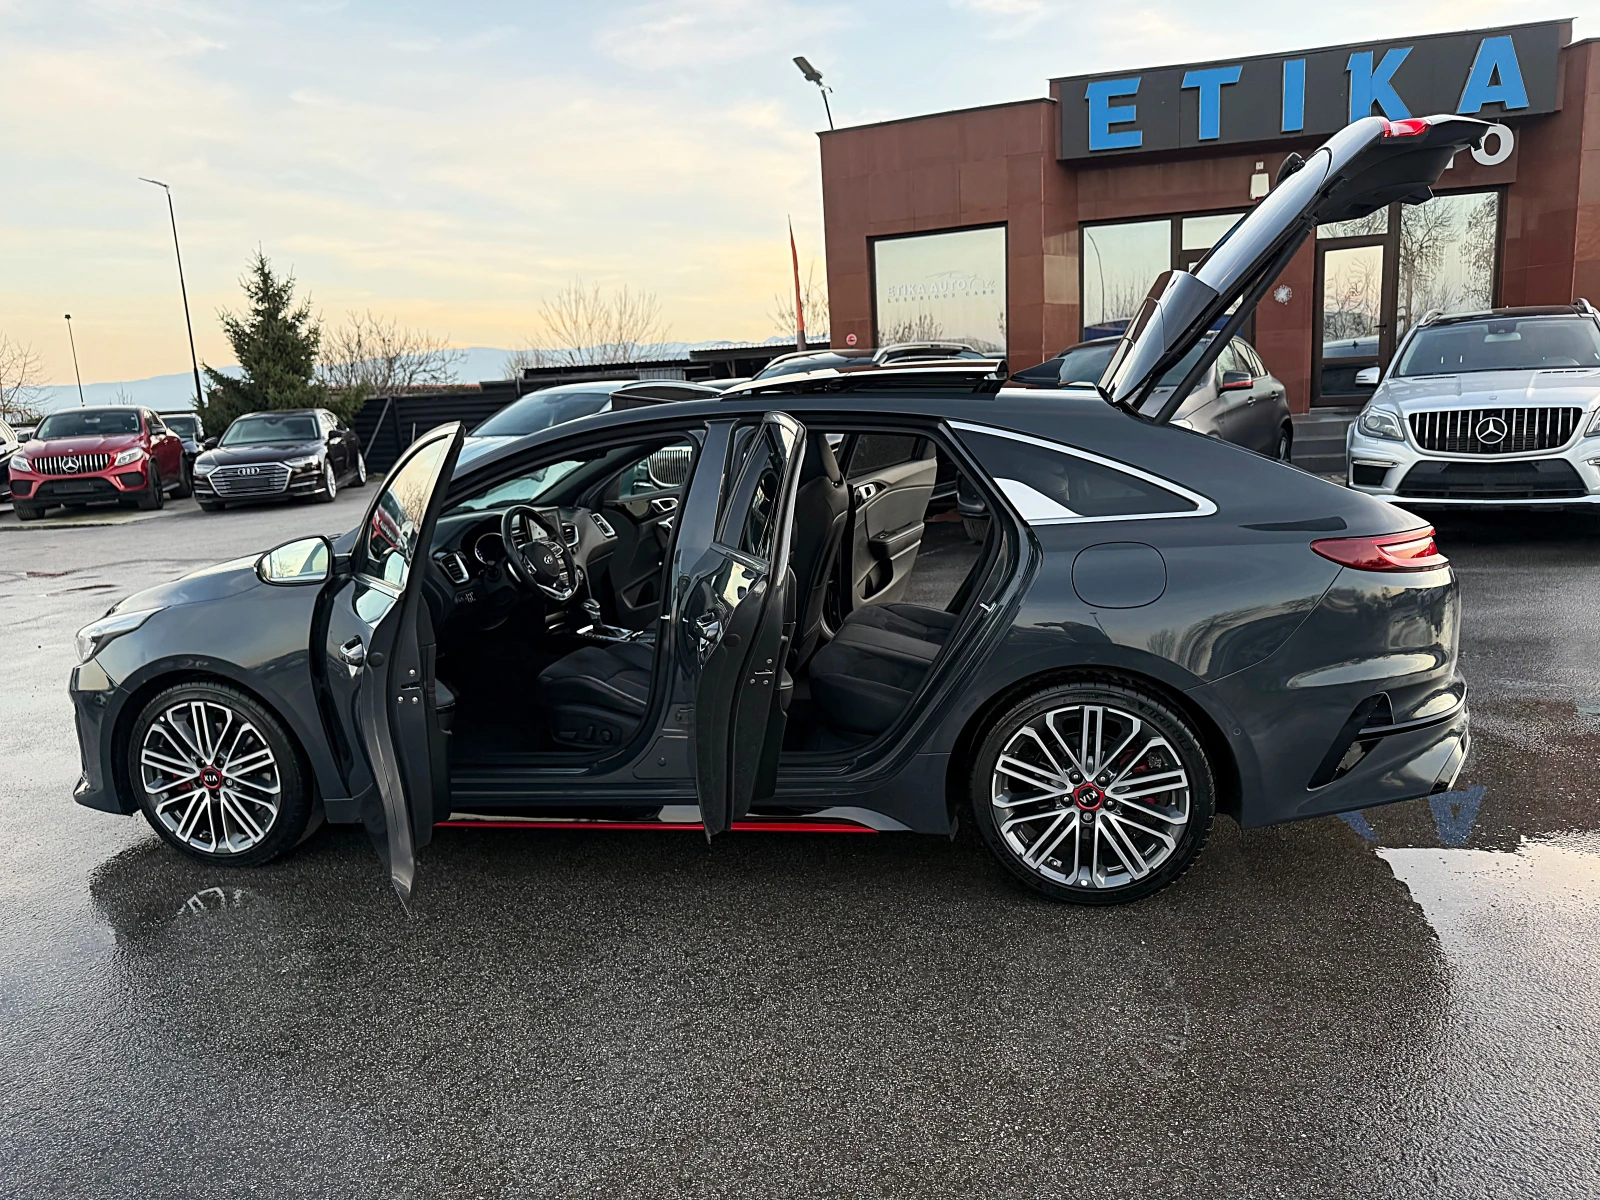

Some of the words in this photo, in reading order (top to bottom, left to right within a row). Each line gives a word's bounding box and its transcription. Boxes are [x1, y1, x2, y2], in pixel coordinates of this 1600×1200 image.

[1085, 35, 1529, 151] ETIKA
[887, 283, 926, 297] ETIKA
[930, 279, 967, 293] AUTO
[203, 774, 218, 782] KIA
[1079, 790, 1099, 804] KIA
